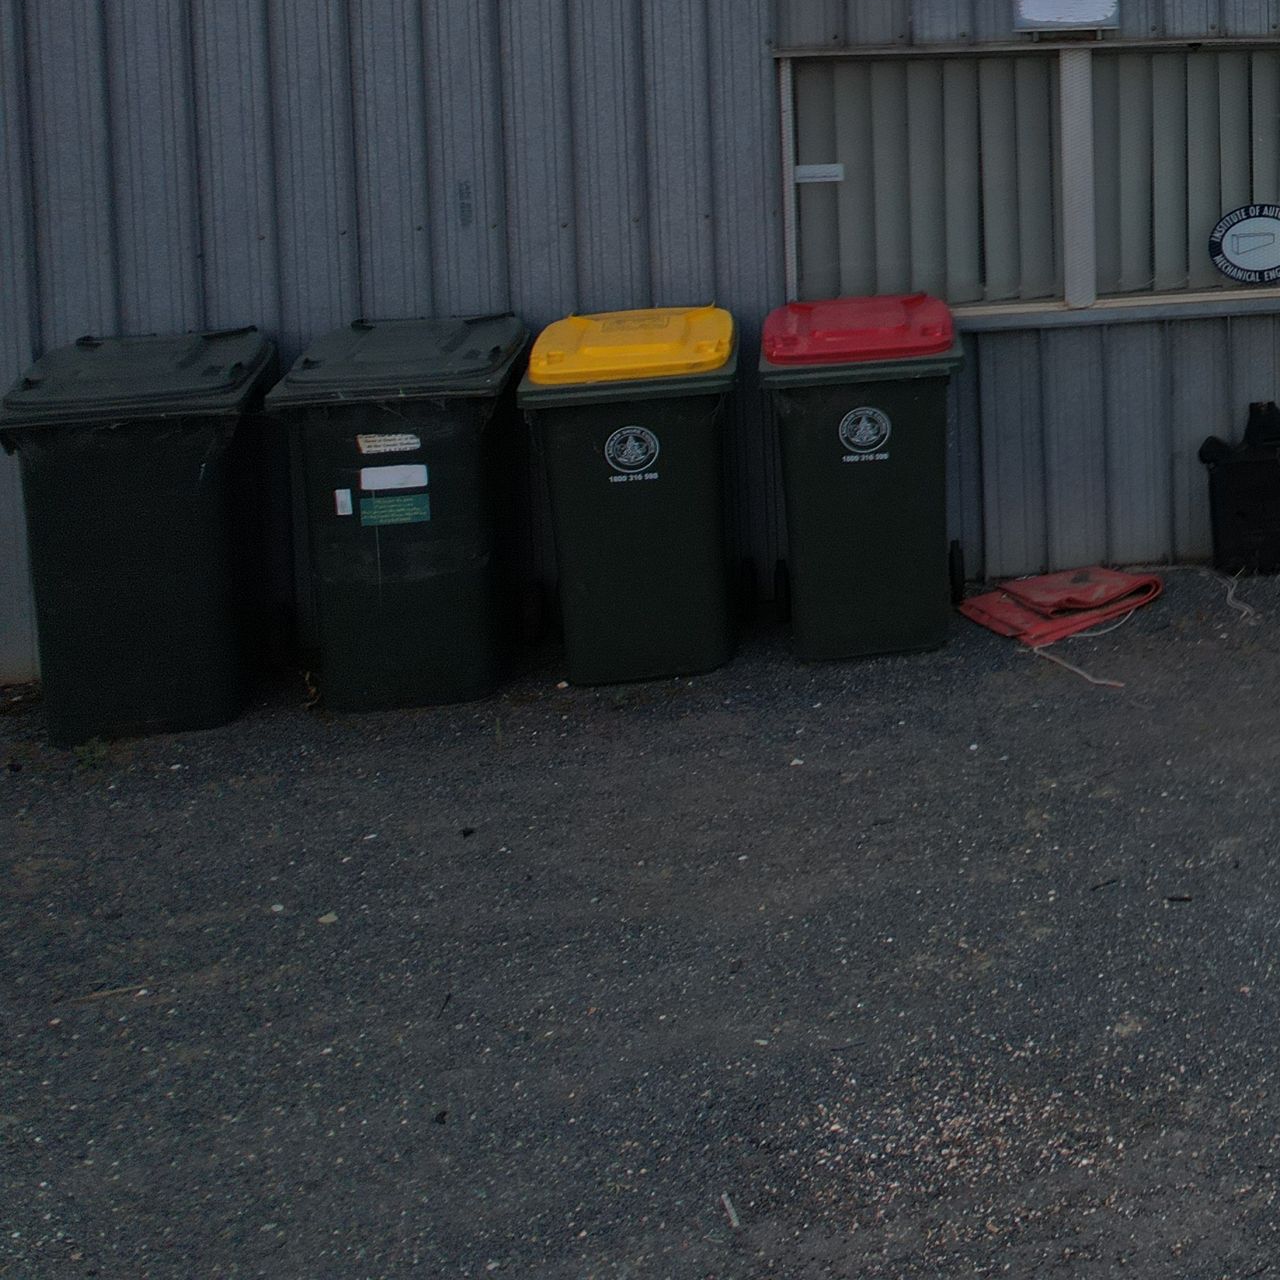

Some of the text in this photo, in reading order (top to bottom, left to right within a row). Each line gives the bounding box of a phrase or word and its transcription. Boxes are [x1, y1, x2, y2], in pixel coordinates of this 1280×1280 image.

[1210, 207, 1248, 242] INSTITUTE
[1248, 205, 1261, 217] OF
[1213, 254, 1260, 282] MECHANICAL
